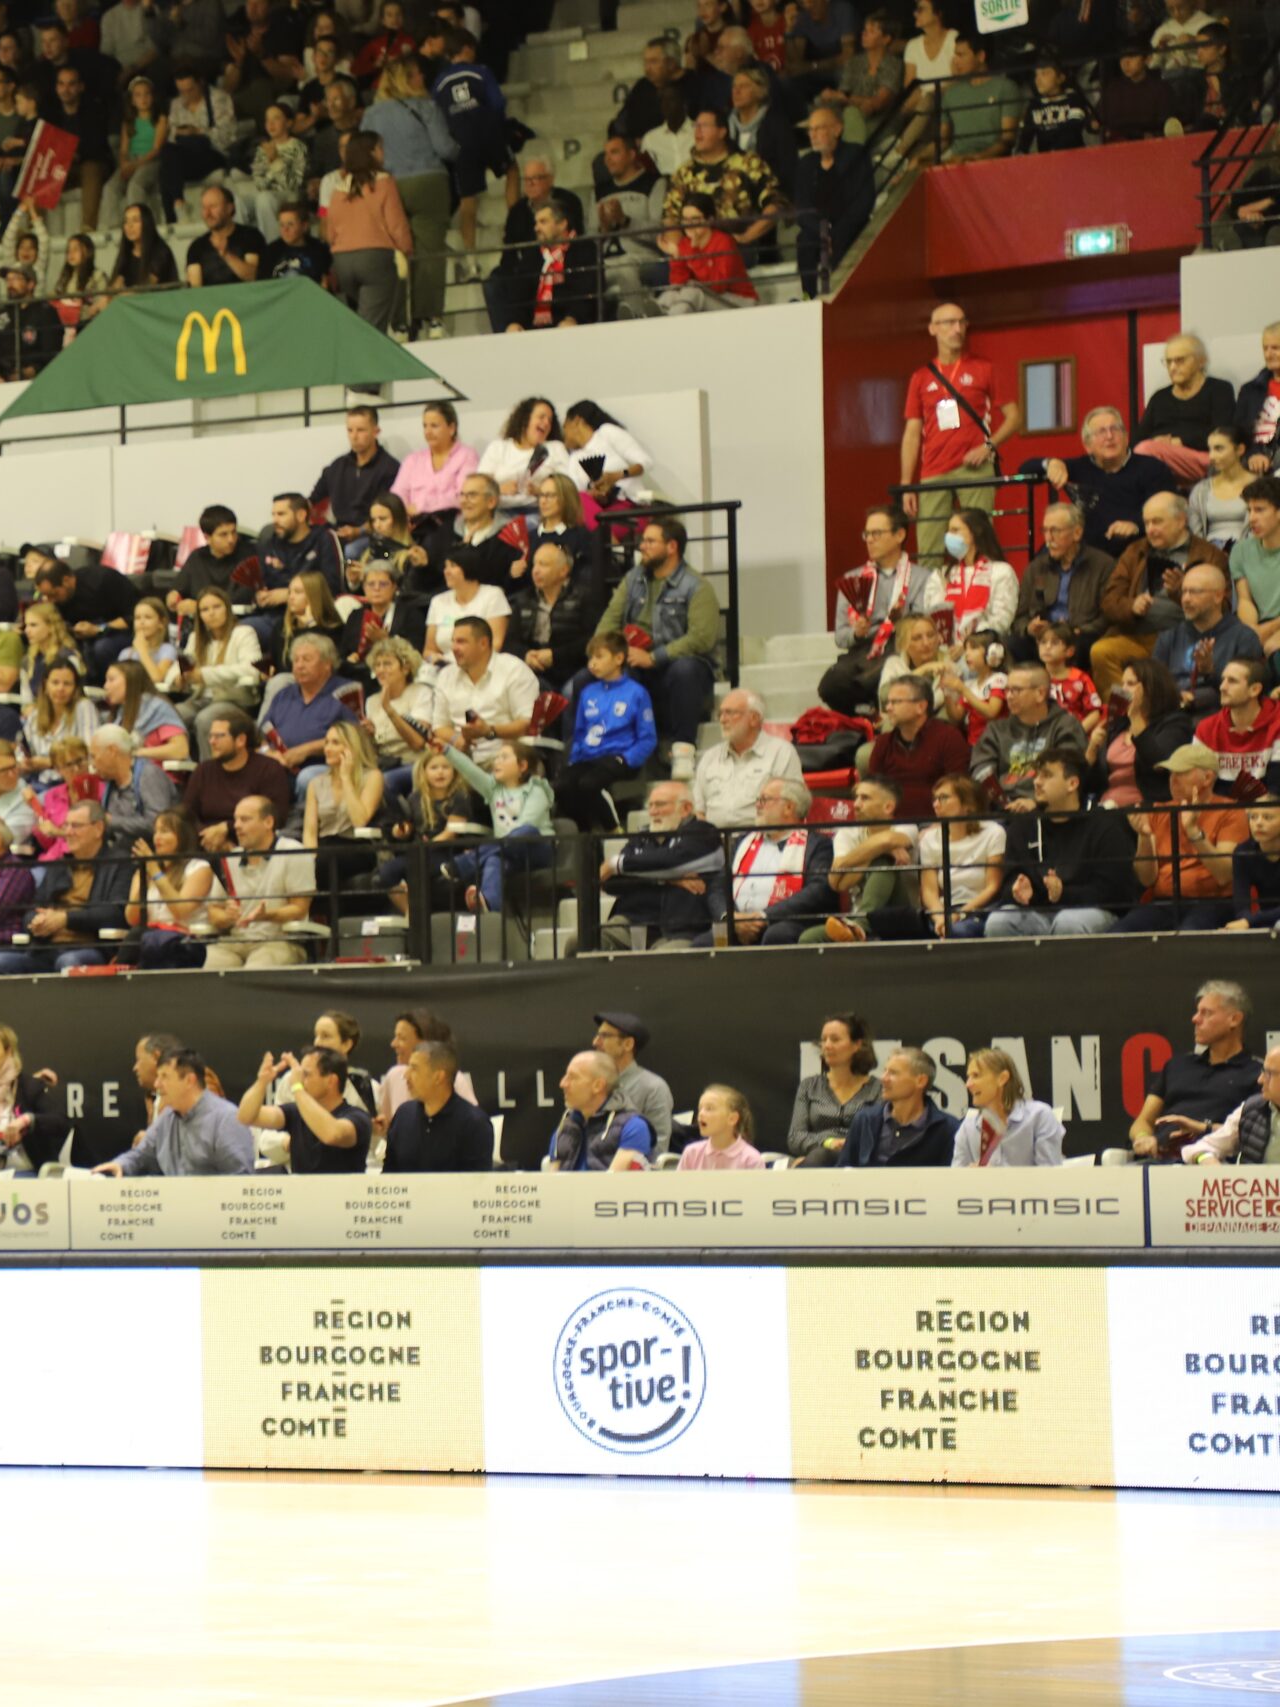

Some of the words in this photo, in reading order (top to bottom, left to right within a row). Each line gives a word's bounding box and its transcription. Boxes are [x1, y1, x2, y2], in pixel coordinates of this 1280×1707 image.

[594, 1200, 743, 1218] SAMSIC
[772, 1198, 927, 1217] SAMSIC
[957, 1197, 1120, 1216] SAMSIC
[260, 1345, 421, 1366] BOURGOGNE
[855, 1348, 1041, 1371] BOURGOGNE
[281, 1381, 401, 1402] FRANCHE
[880, 1388, 1019, 1411] FRANCHE
